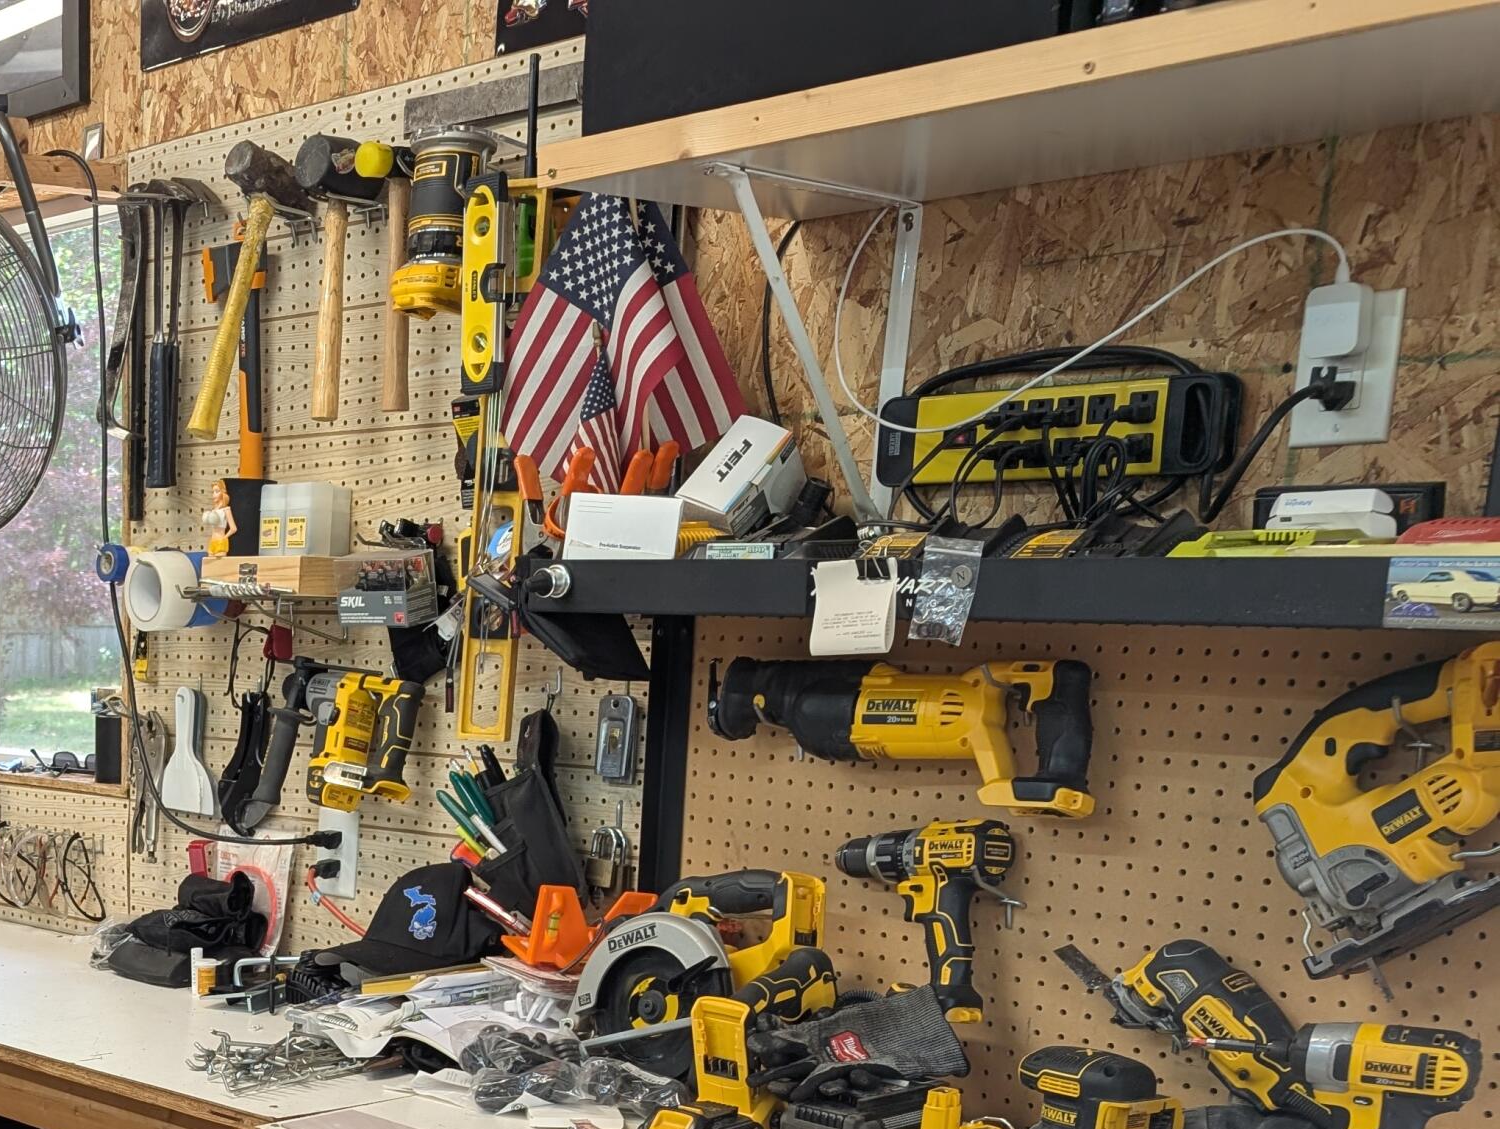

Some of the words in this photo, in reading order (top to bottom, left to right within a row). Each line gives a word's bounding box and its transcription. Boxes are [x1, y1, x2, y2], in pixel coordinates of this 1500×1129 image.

[716, 438, 752, 483] FEIT
[340, 596, 365, 608] SKIL
[866, 699, 917, 712] DEWALT
[1381, 806, 1422, 836] DEWALT
[929, 839, 964, 850] DEWALT
[608, 924, 657, 951] DEWALT
[1364, 1061, 1413, 1075] DEWALT
